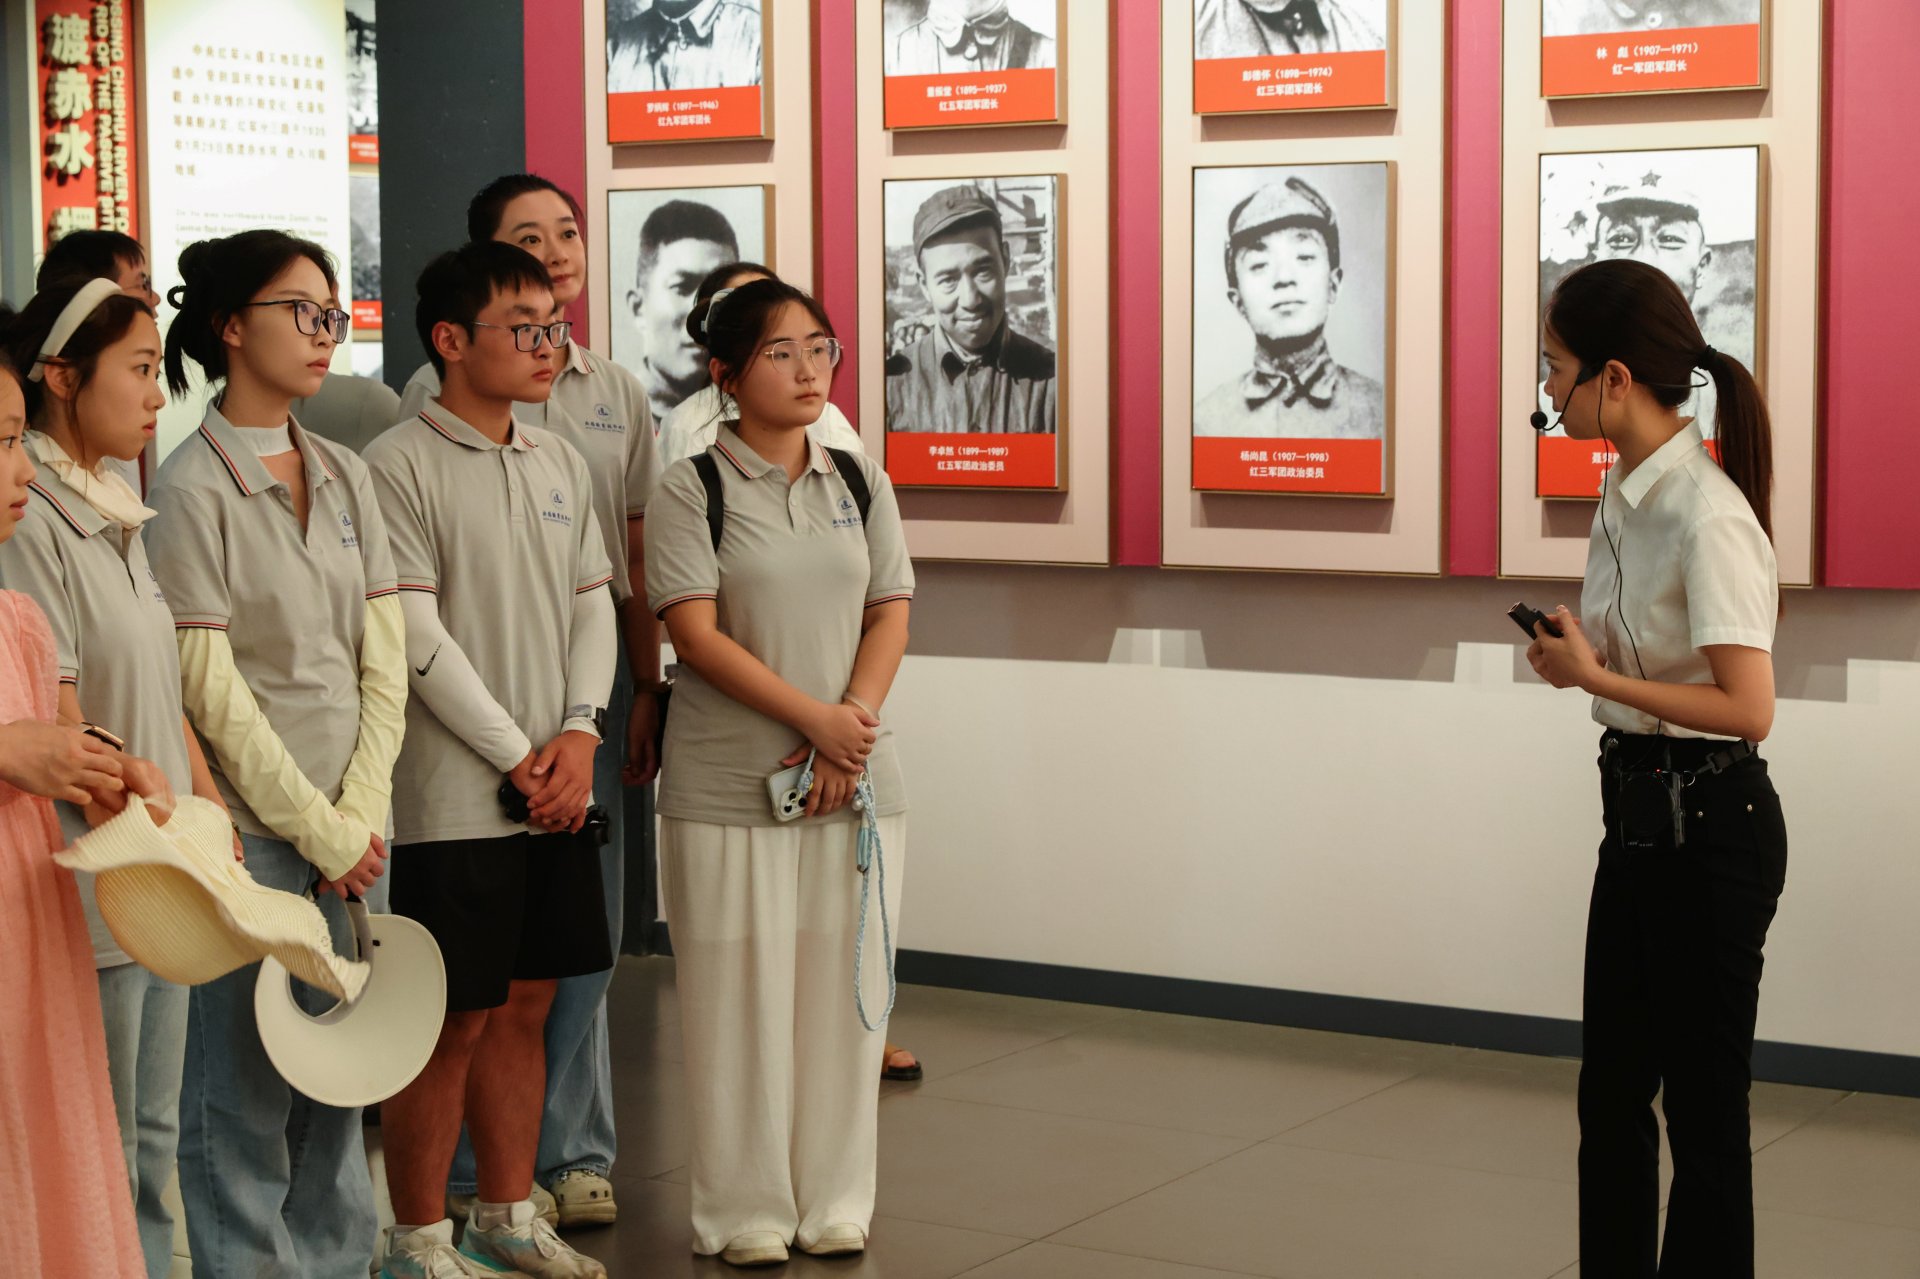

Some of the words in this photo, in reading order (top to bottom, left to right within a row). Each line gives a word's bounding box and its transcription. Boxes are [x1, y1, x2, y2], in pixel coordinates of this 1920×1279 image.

[96, 5, 109, 38] RID
[109, 0, 125, 62] SSING
[96, 41, 110, 67] OF
[1612, 59, 1687, 75] 红一军团军团长
[50, 12, 94, 175] 渡赤水
[97, 72, 112, 110] THE
[1256, 82, 1323, 96] 红三军团军团长
[111, 66, 127, 142] CHISHUI
[939, 98, 998, 111] 红五军团军团长
[658, 114, 711, 126] 红九军团军团长
[99, 113, 114, 193] PASSIVE
[114, 146, 128, 202] RIVER
[937, 460, 1004, 471] 红五军团政治委员
[1240, 450, 1330, 462] 杨尚昆（1907—1998）
[1249, 466, 1324, 478] 红三军团政治委员
